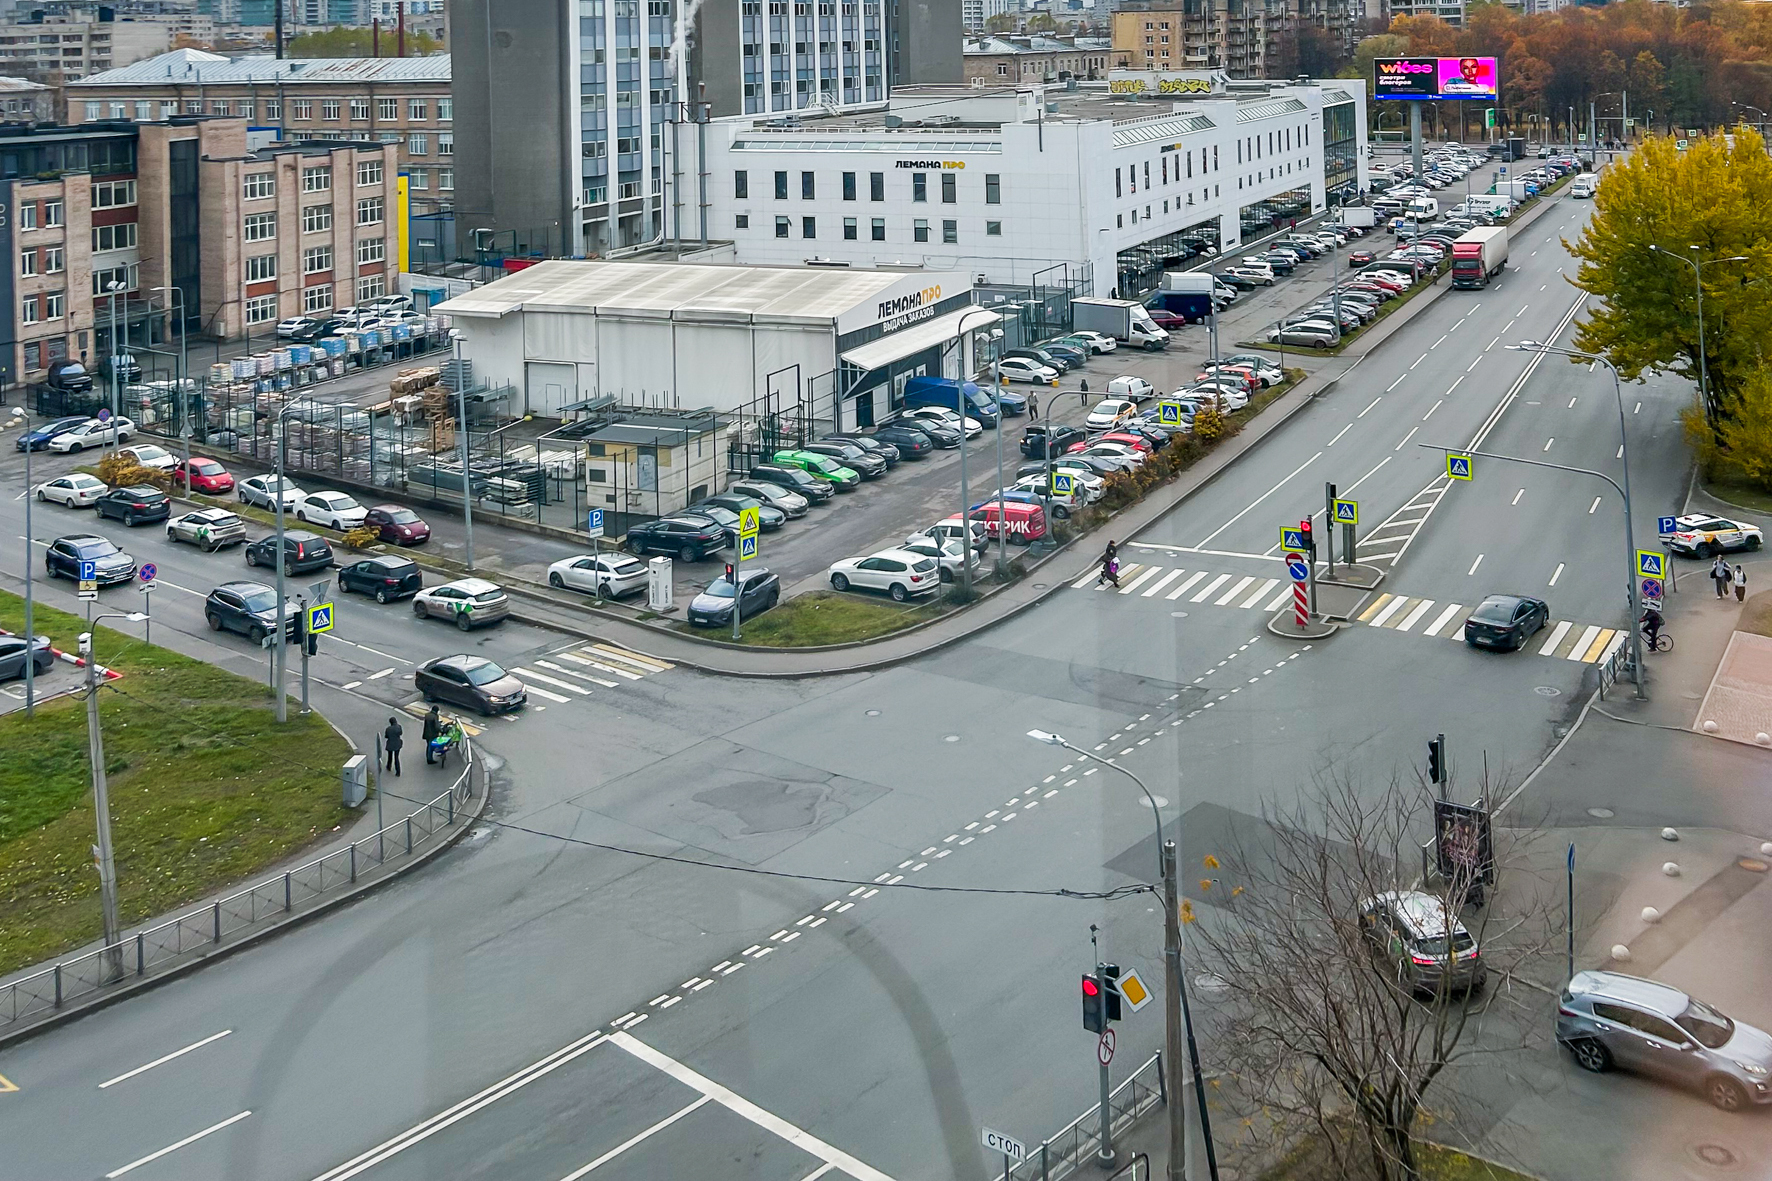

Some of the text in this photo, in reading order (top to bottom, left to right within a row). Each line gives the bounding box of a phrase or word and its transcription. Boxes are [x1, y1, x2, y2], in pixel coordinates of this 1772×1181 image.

[942, 161, 965, 169] ПРО
[878, 285, 941, 319] ЛЕМАНА ПРО
[883, 305, 935, 332] ВЫДАЧА ЗАКАЗОВ
[1663, 518, 1673, 532] P
[84, 563, 93, 578] P
[988, 1133, 1020, 1158] СТОП
